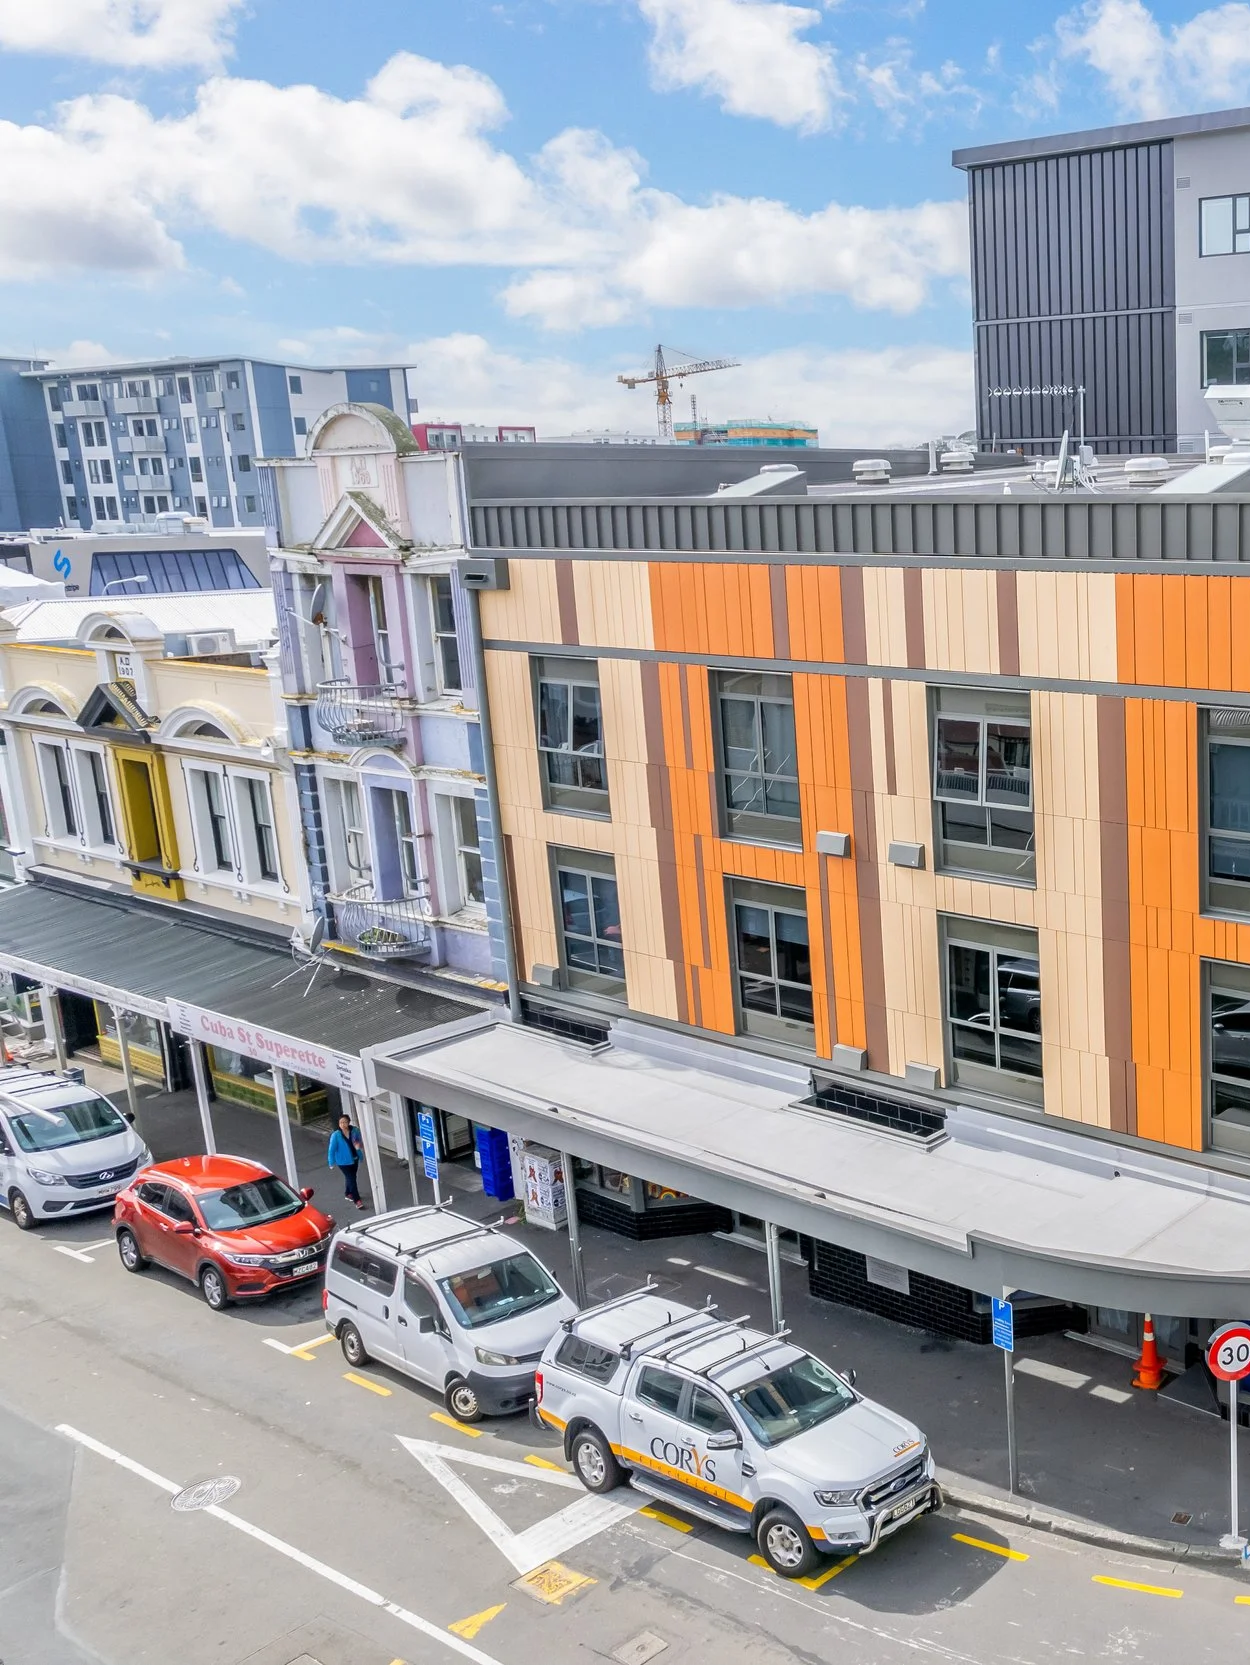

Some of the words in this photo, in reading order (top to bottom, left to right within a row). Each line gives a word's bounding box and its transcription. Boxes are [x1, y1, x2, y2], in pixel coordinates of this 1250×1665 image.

[200, 1014, 235, 1040] Cuba
[237, 1026, 253, 1046] St
[255, 1031, 327, 1070] Superette
[998, 1300, 1005, 1311] P
[1221, 1343, 1250, 1366] 30
[650, 1437, 716, 1482] CORYS
